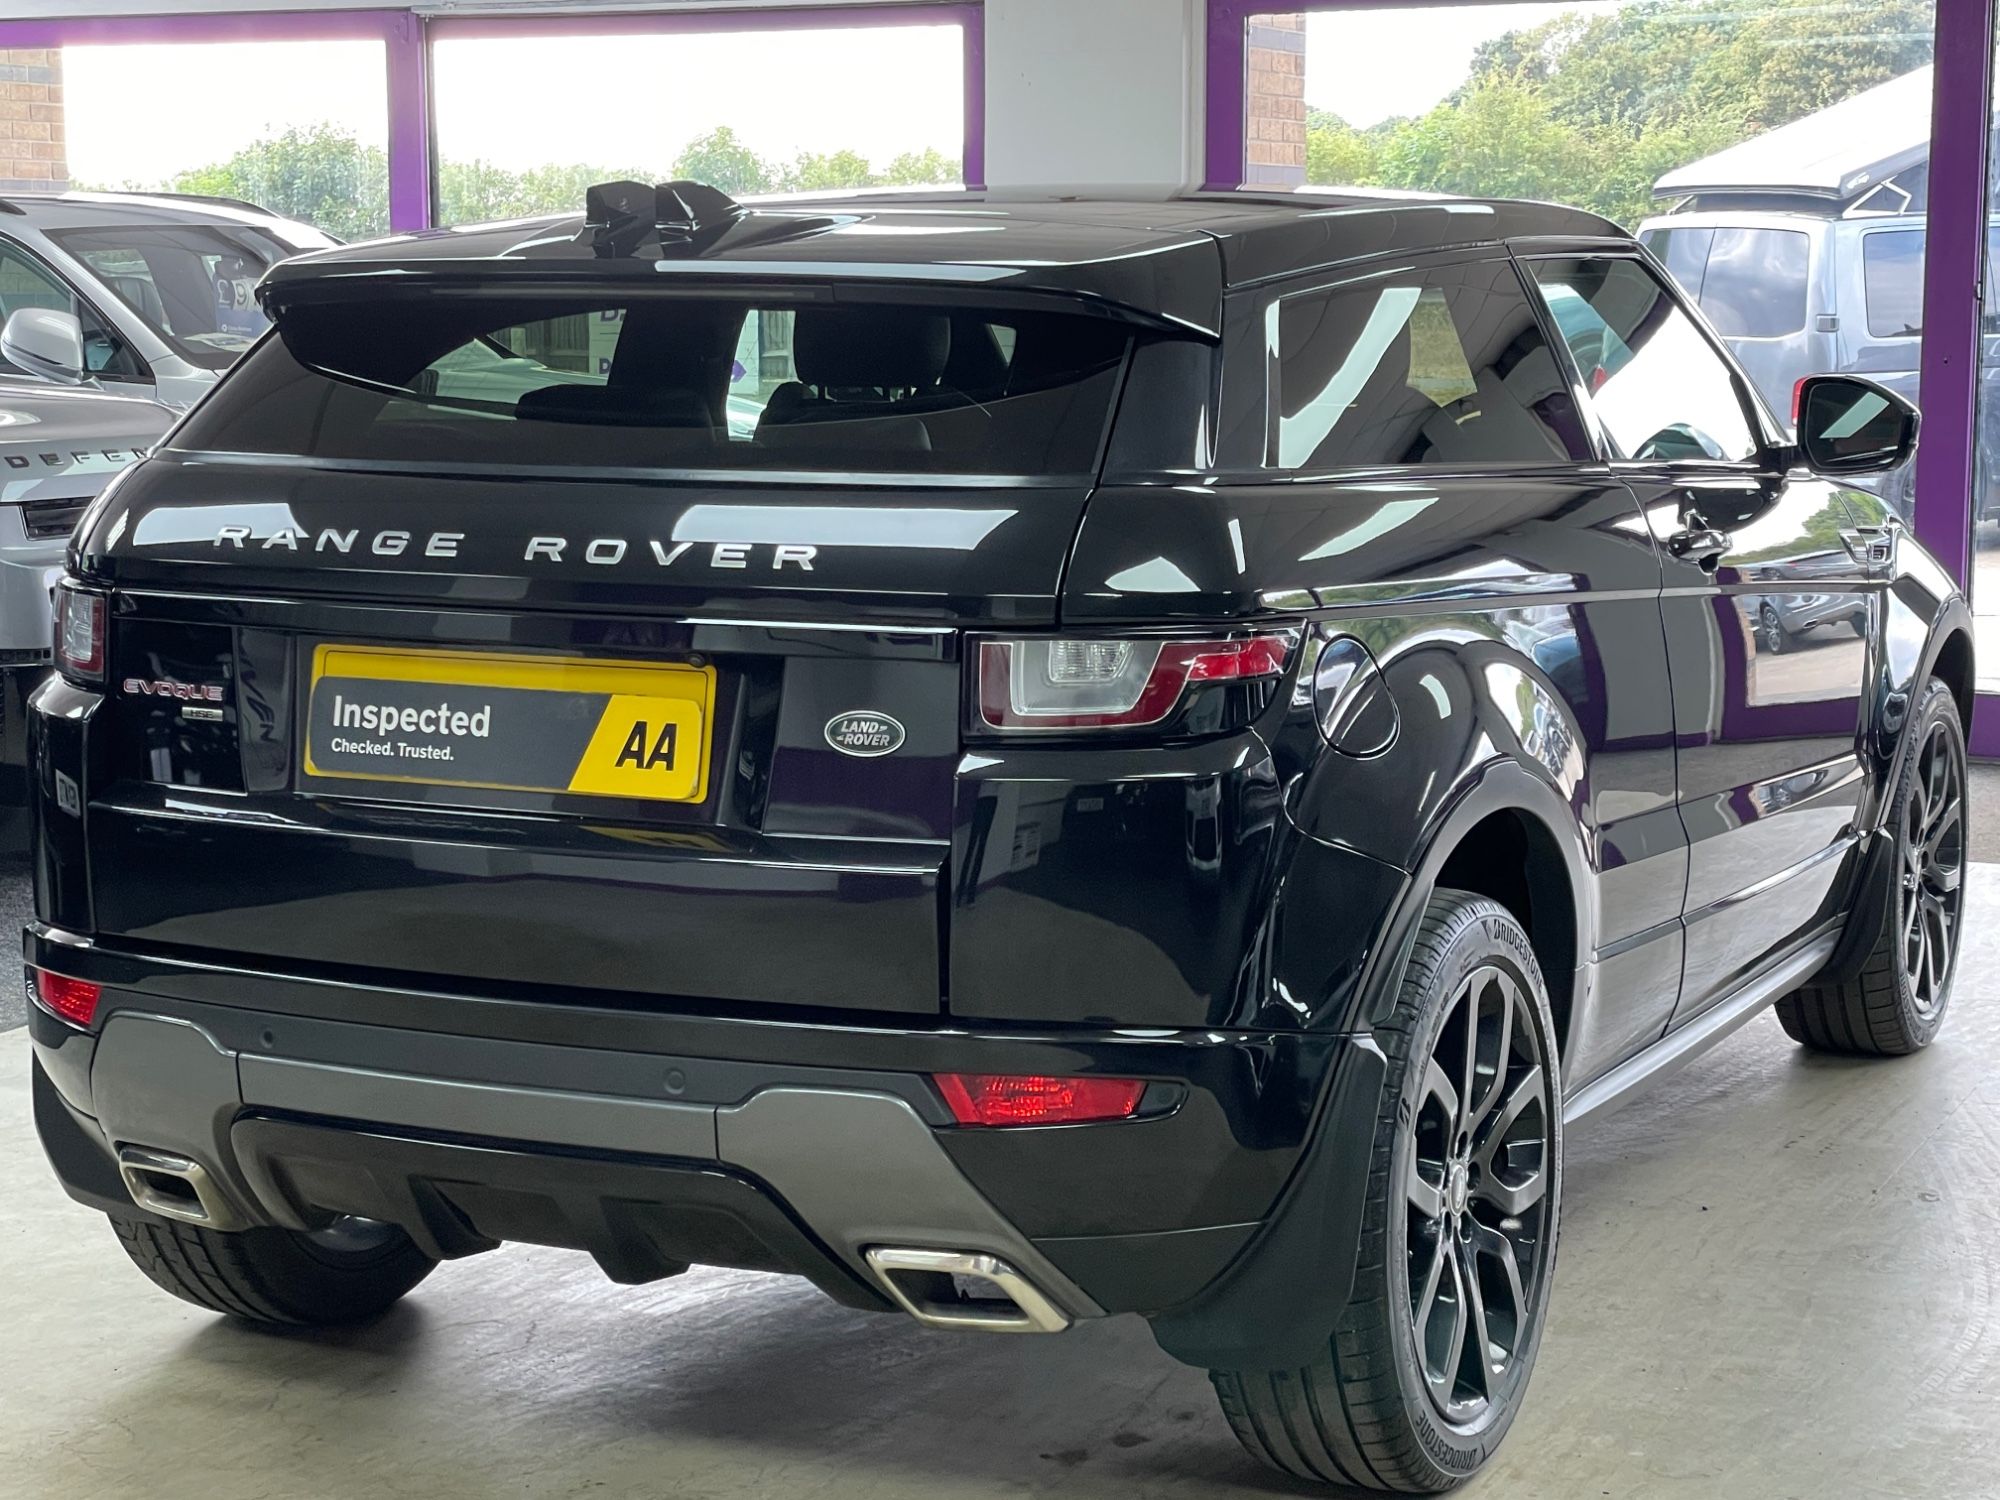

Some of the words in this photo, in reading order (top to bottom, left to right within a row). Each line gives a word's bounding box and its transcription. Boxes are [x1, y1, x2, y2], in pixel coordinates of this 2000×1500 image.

[213, 524, 465, 557] RANGE
[524, 536, 818, 570] ROVER
[123, 678, 223, 701] EVOQUE
[332, 694, 491, 738] Inspected
[841, 721, 879, 733] LAND
[331, 737, 395, 757] Checked.
[398, 742, 454, 761] Trusted.
[615, 720, 677, 771] AA
[844, 733, 890, 746] ROVER
[1494, 918, 1543, 993] BRIDGESTONE
[1415, 1409, 1478, 1470] BRIDGESTONE
